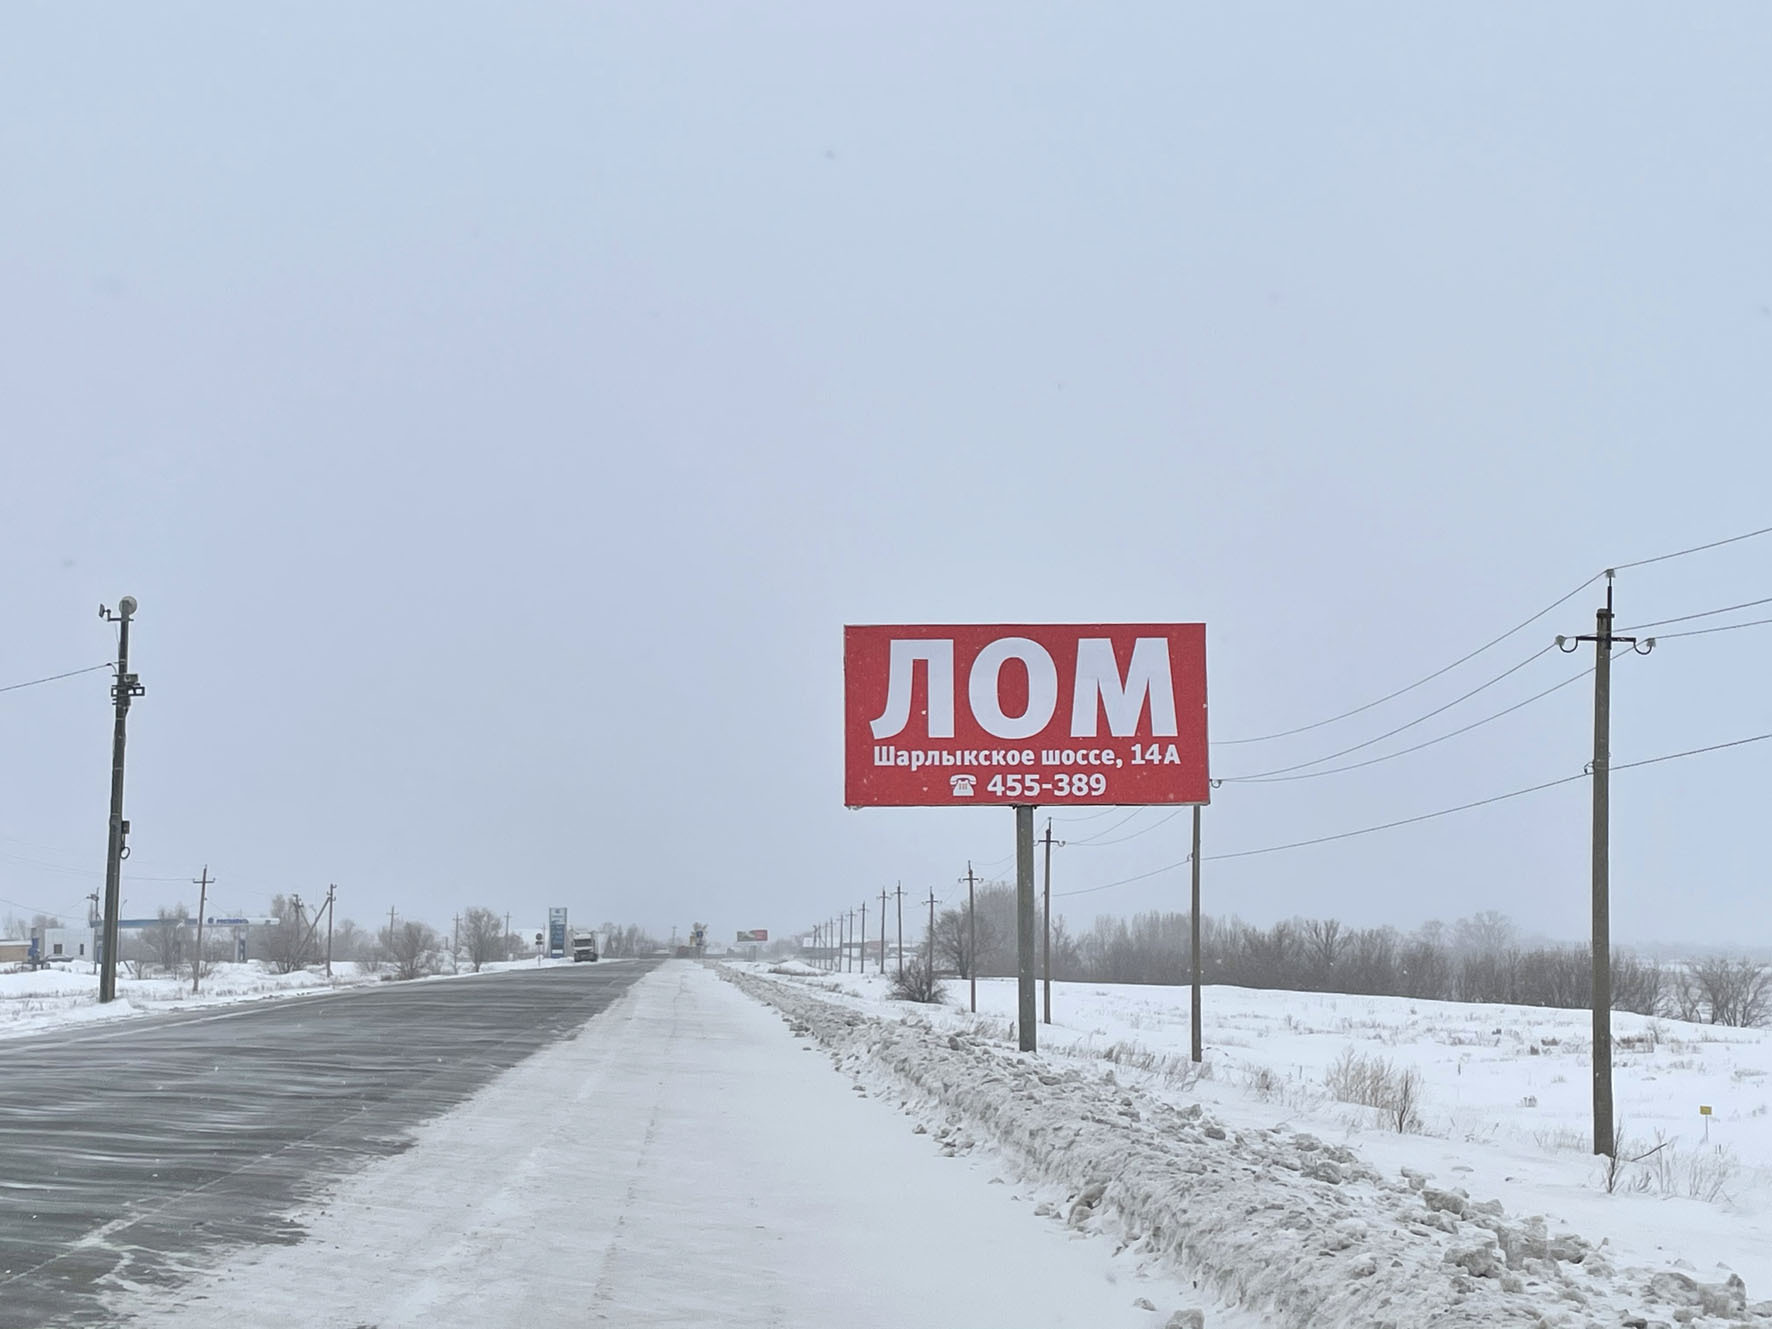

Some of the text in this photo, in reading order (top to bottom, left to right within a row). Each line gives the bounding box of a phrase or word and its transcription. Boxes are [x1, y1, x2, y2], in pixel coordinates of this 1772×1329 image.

[869, 637, 1178, 739] ЛОМ
[873, 744, 1181, 771] Шарлыкское шоссе, 14А
[986, 773, 1107, 797] 455-389
